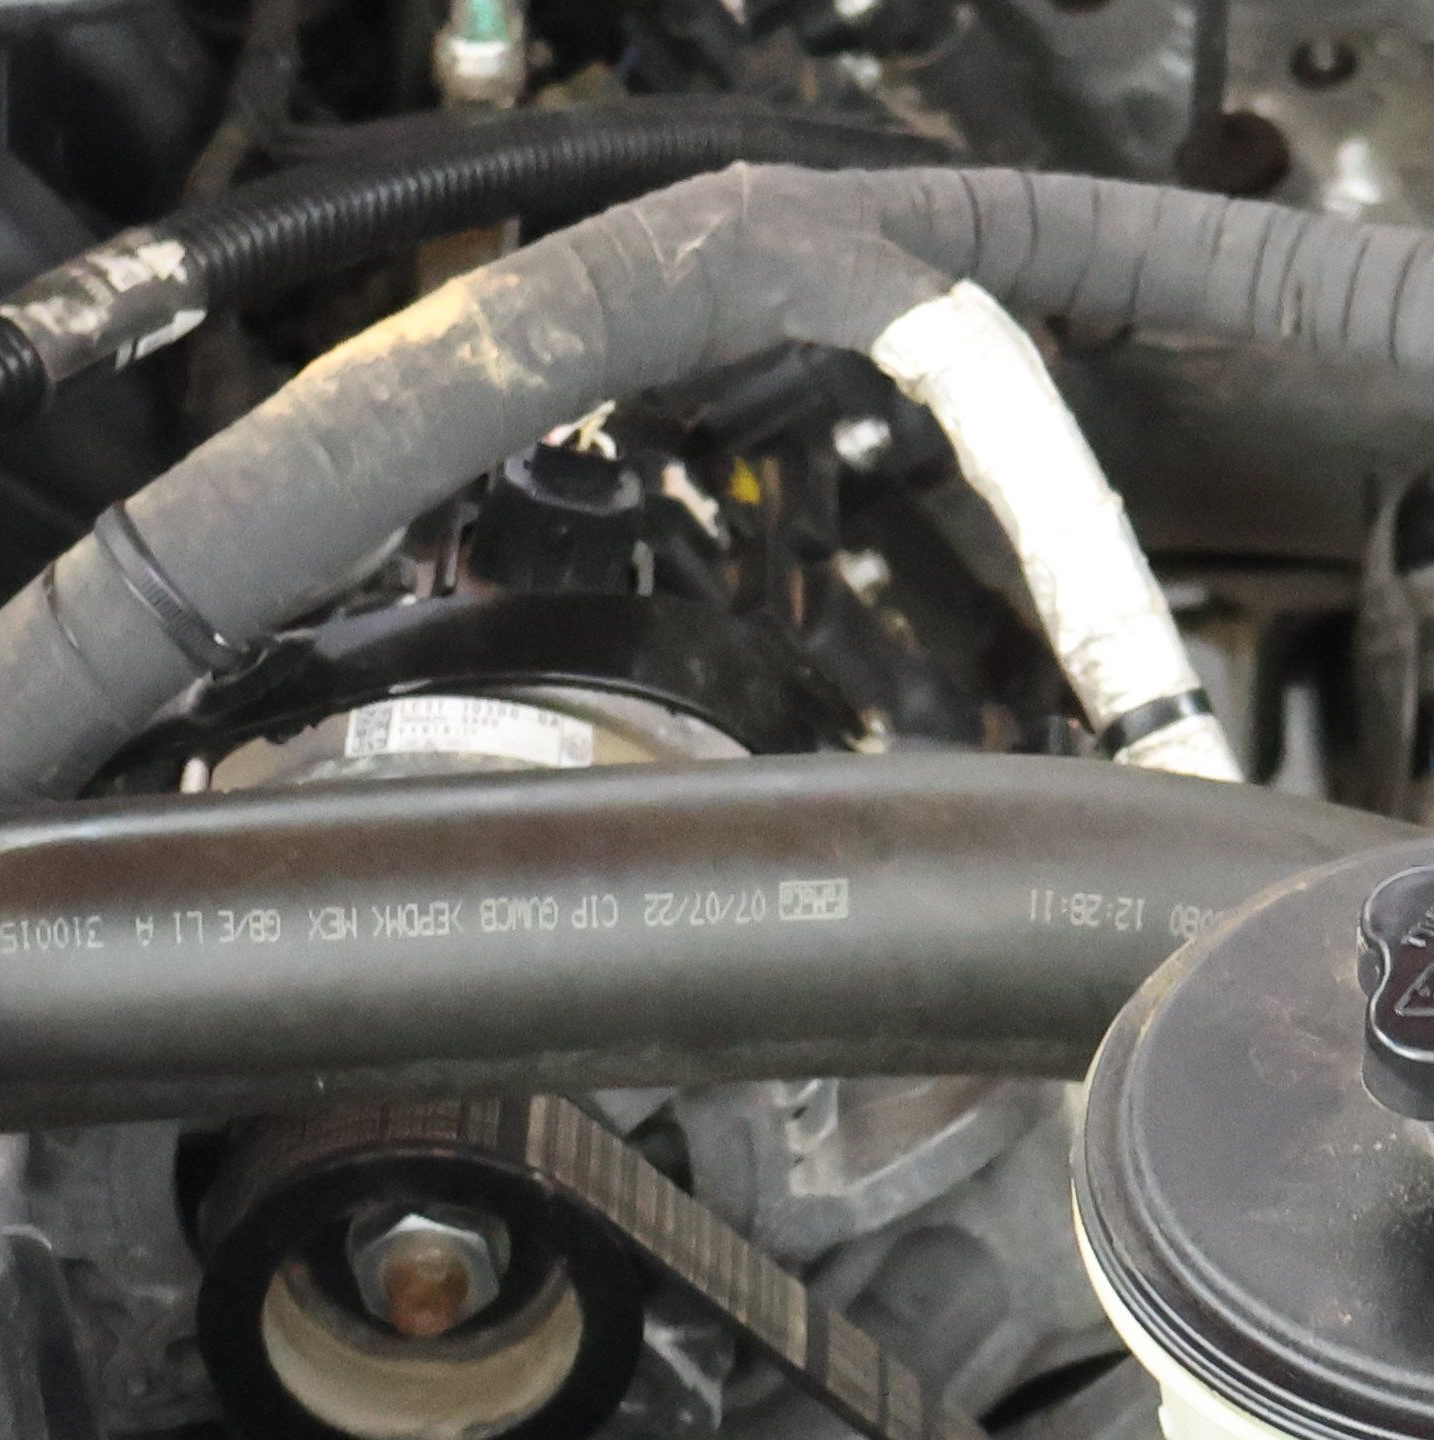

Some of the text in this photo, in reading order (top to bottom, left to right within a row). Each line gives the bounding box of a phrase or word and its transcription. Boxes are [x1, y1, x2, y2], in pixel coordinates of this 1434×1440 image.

[307, 905, 359, 940] MEX
[643, 890, 766, 925] 07/07/22
[1029, 888, 1145, 932] 12:28:11
[135, 916, 155, 944] A
